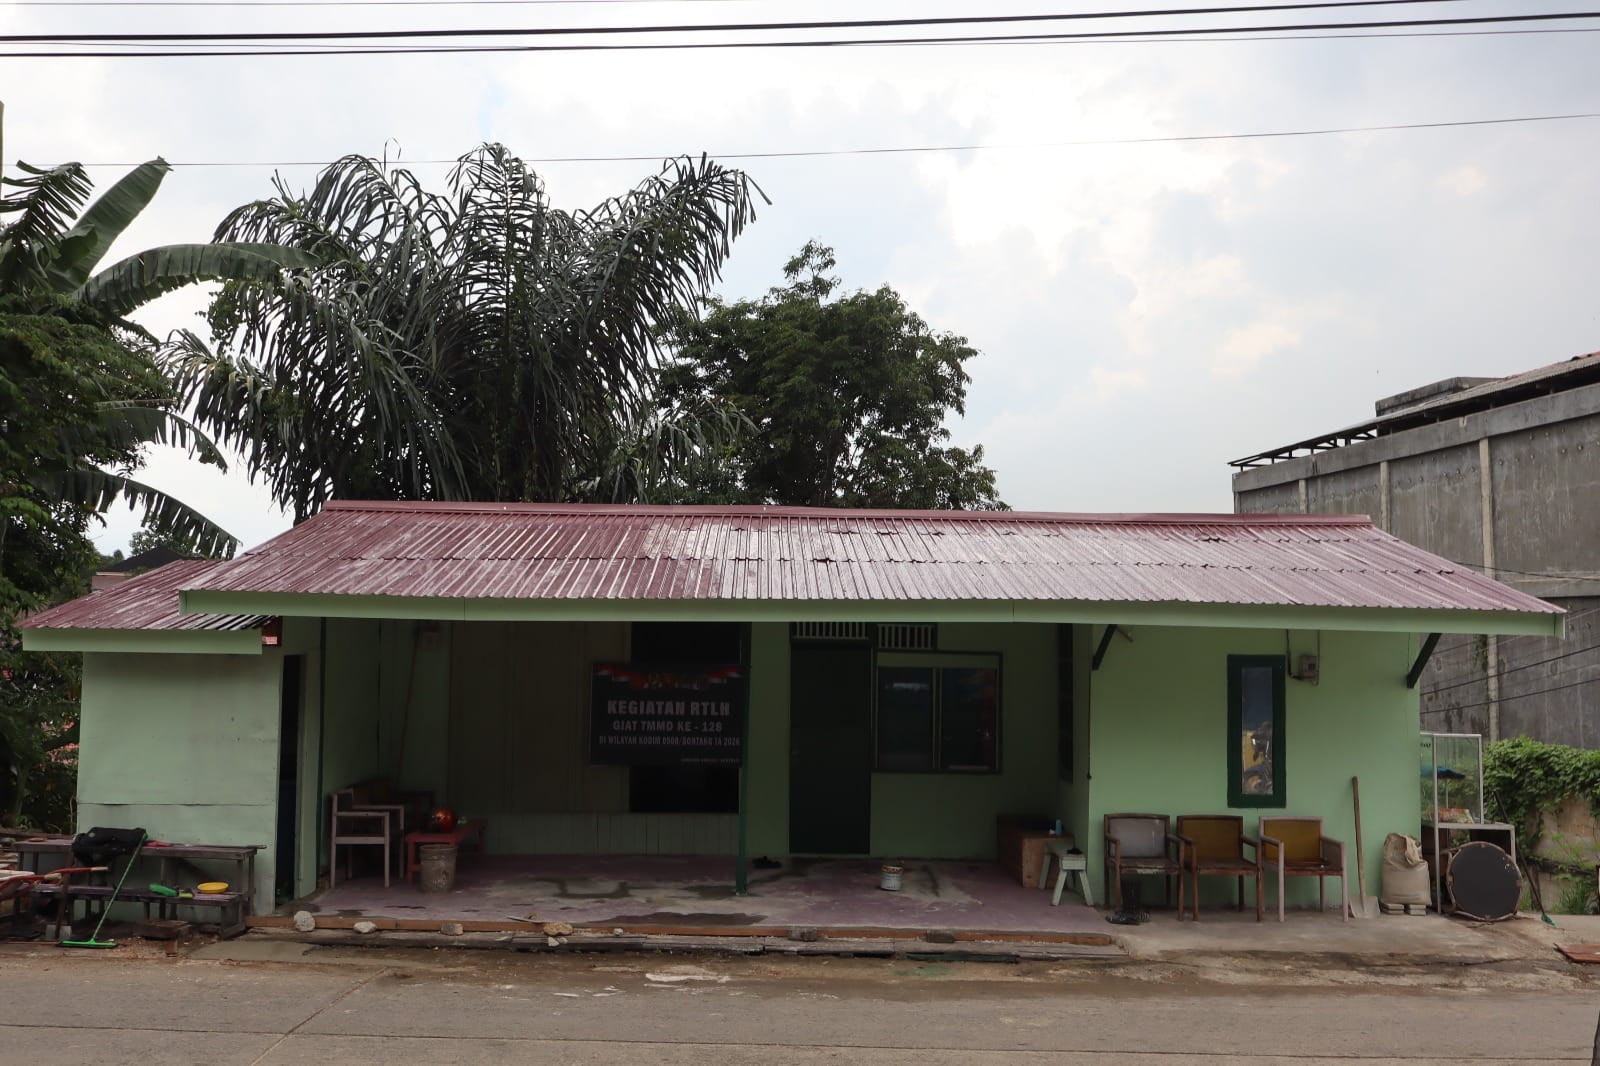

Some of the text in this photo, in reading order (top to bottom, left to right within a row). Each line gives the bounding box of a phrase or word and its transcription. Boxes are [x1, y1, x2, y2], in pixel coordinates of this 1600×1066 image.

[607, 700, 730, 716] KEGIATAN RTLH
[612, 719, 638, 731] GIAT
[640, 720, 674, 732] TMMD
[677, 720, 692, 732] KE
[599, 735, 606, 745] DI
[608, 735, 637, 745] WILAYAH
[639, 735, 661, 745] KODIM
